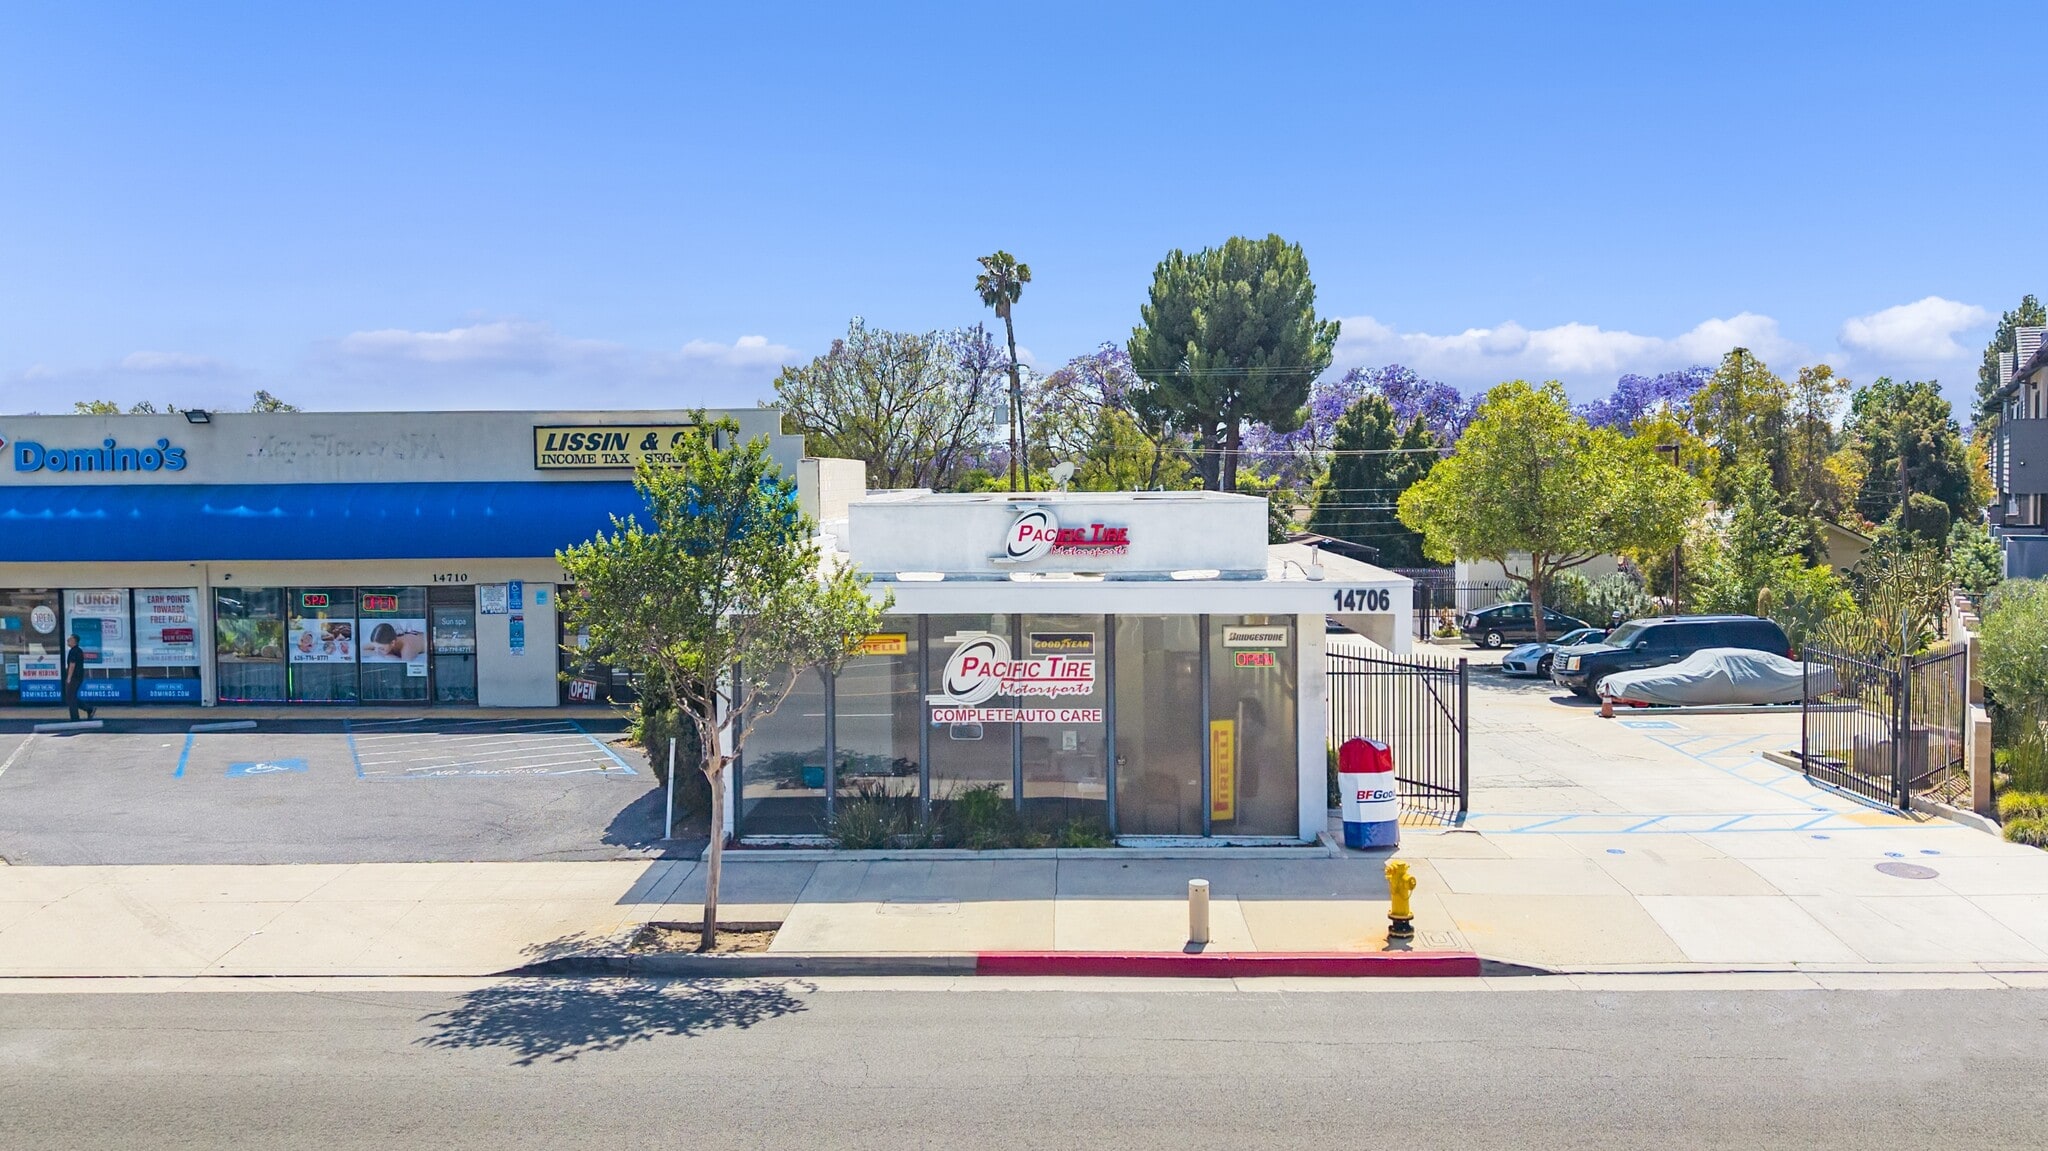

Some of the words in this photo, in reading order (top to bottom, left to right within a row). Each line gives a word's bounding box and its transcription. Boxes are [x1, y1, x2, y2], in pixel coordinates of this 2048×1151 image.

[544, 432, 630, 451] LISSIN
[639, 432, 658, 450] &
[14, 438, 188, 472] Domino's
[541, 454, 597, 464] INCOME
[602, 454, 630, 464] TAX
[1050, 545, 1128, 557] Motorsports
[433, 573, 468, 583] 14710
[76, 594, 120, 605] LUNCH
[147, 595, 164, 604] EARN
[166, 595, 191, 603] POINTS
[304, 594, 327, 606] SPA
[364, 594, 397, 610] OPEN
[1334, 589, 1390, 612] 14706
[153, 605, 185, 614] TOWARDS
[441, 617, 455, 626] Sun
[455, 619, 467, 628] spa
[452, 631, 459, 641] 7
[1228, 632, 1284, 641] BRIDGESTONE
[1236, 653, 1274, 666] OPEN
[570, 680, 596, 700] OPEN
[1000, 682, 1091, 698] Motorsports
[933, 709, 1013, 721] COMPLETE
[1015, 710, 1056, 721] AUTO
[1060, 710, 1102, 721] CARE
[1213, 730, 1228, 812] PIRELLI
[1356, 790, 1395, 799] BFGoo
